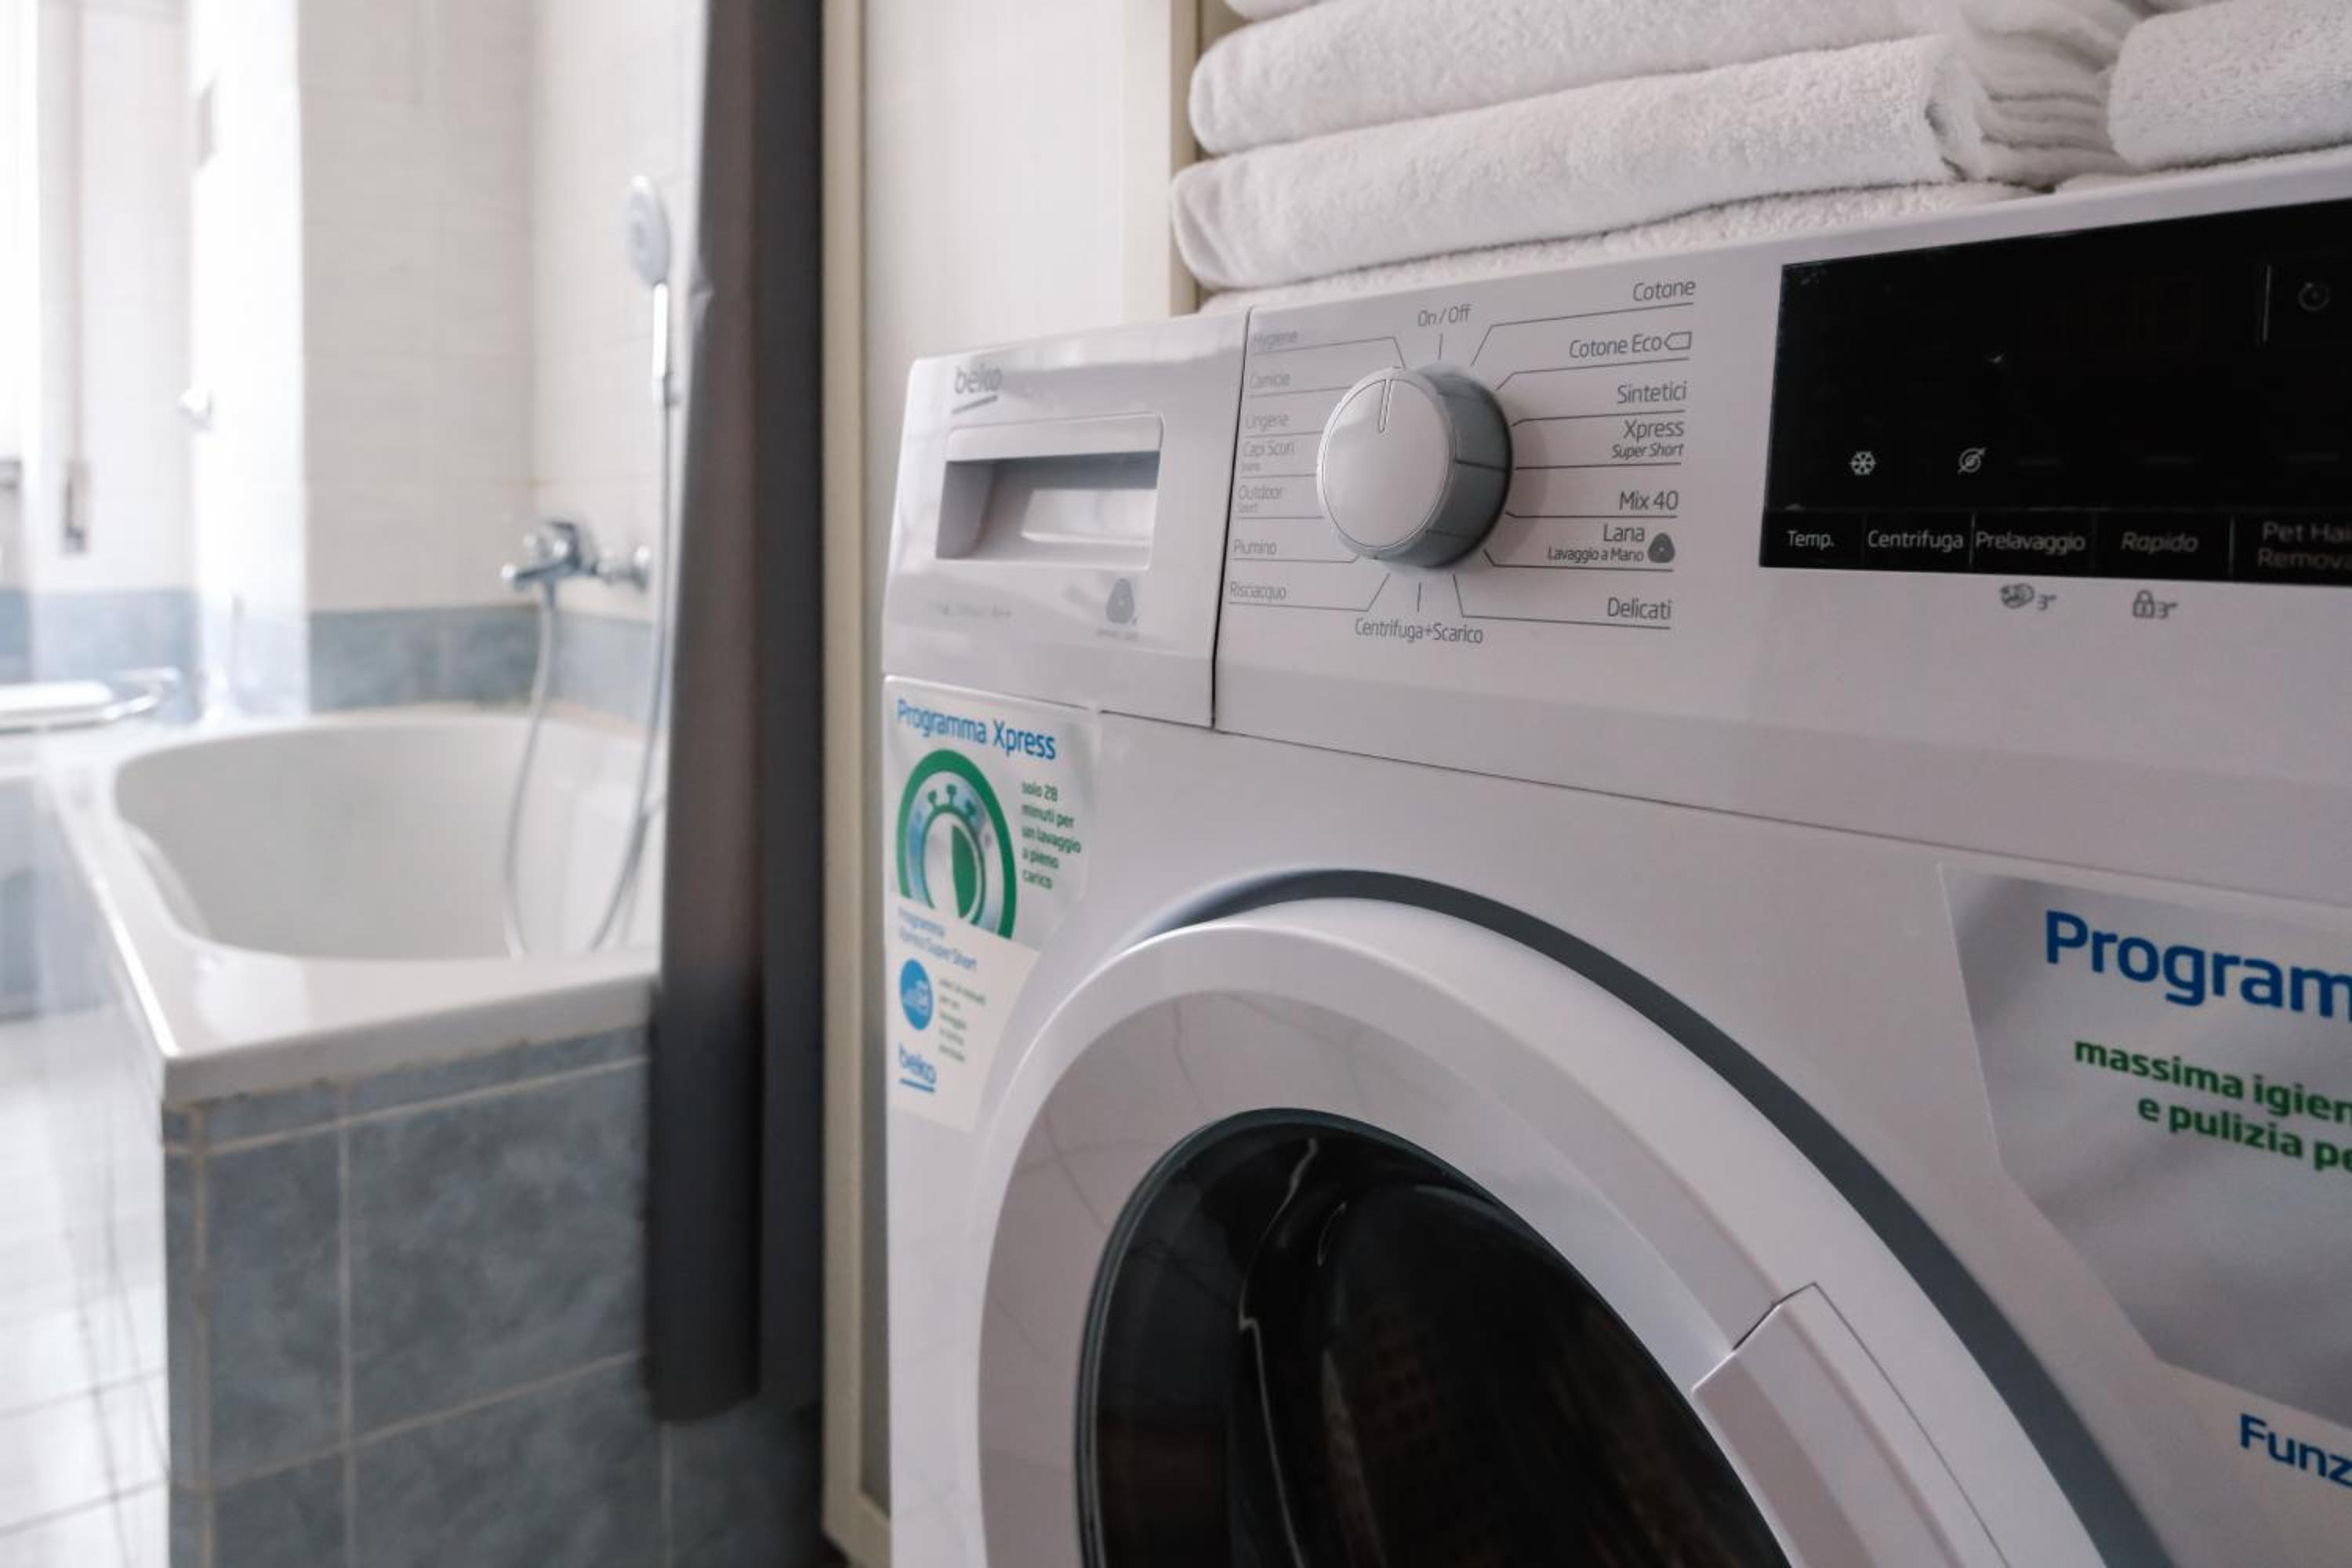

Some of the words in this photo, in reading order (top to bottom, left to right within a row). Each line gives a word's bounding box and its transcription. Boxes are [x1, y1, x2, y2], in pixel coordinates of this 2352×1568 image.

[1633, 279, 1697, 302] Cotone
[1417, 310, 1437, 327] On
[1448, 303, 1472, 324] Off
[1569, 337, 1628, 358] Cotone
[1632, 334, 1663, 353] Eco
[1617, 381, 1688, 404] Sintetici
[1623, 419, 1684, 441] Xpress
[1611, 445, 1648, 460] Super
[1650, 442, 1683, 457] Short
[1619, 491, 1650, 510] Mix
[1653, 490, 1679, 510] 40
[1603, 524, 1646, 542] Lana
[1787, 530, 1835, 552] Temp.
[1867, 529, 1964, 551] Centrifuga
[1975, 530, 2085, 554] Prelavaggio
[2122, 531, 2198, 554] Rapido
[2261, 521, 2303, 543] Pet
[1548, 546, 1599, 563] Lavaggio
[1601, 550, 1610, 561] a
[1610, 548, 1644, 562] Mano
[1607, 597, 1672, 619] Delicati
[1355, 617, 1483, 644] Centrifuga+Scarico
[897, 698, 987, 744] Programma
[993, 718, 1056, 760] Xpress
[2074, 1039, 2244, 1100] massima
[2137, 1098, 2161, 1123] e
[2169, 1107, 2303, 1160] pulizia
[2240, 1413, 2352, 1488] Funz
